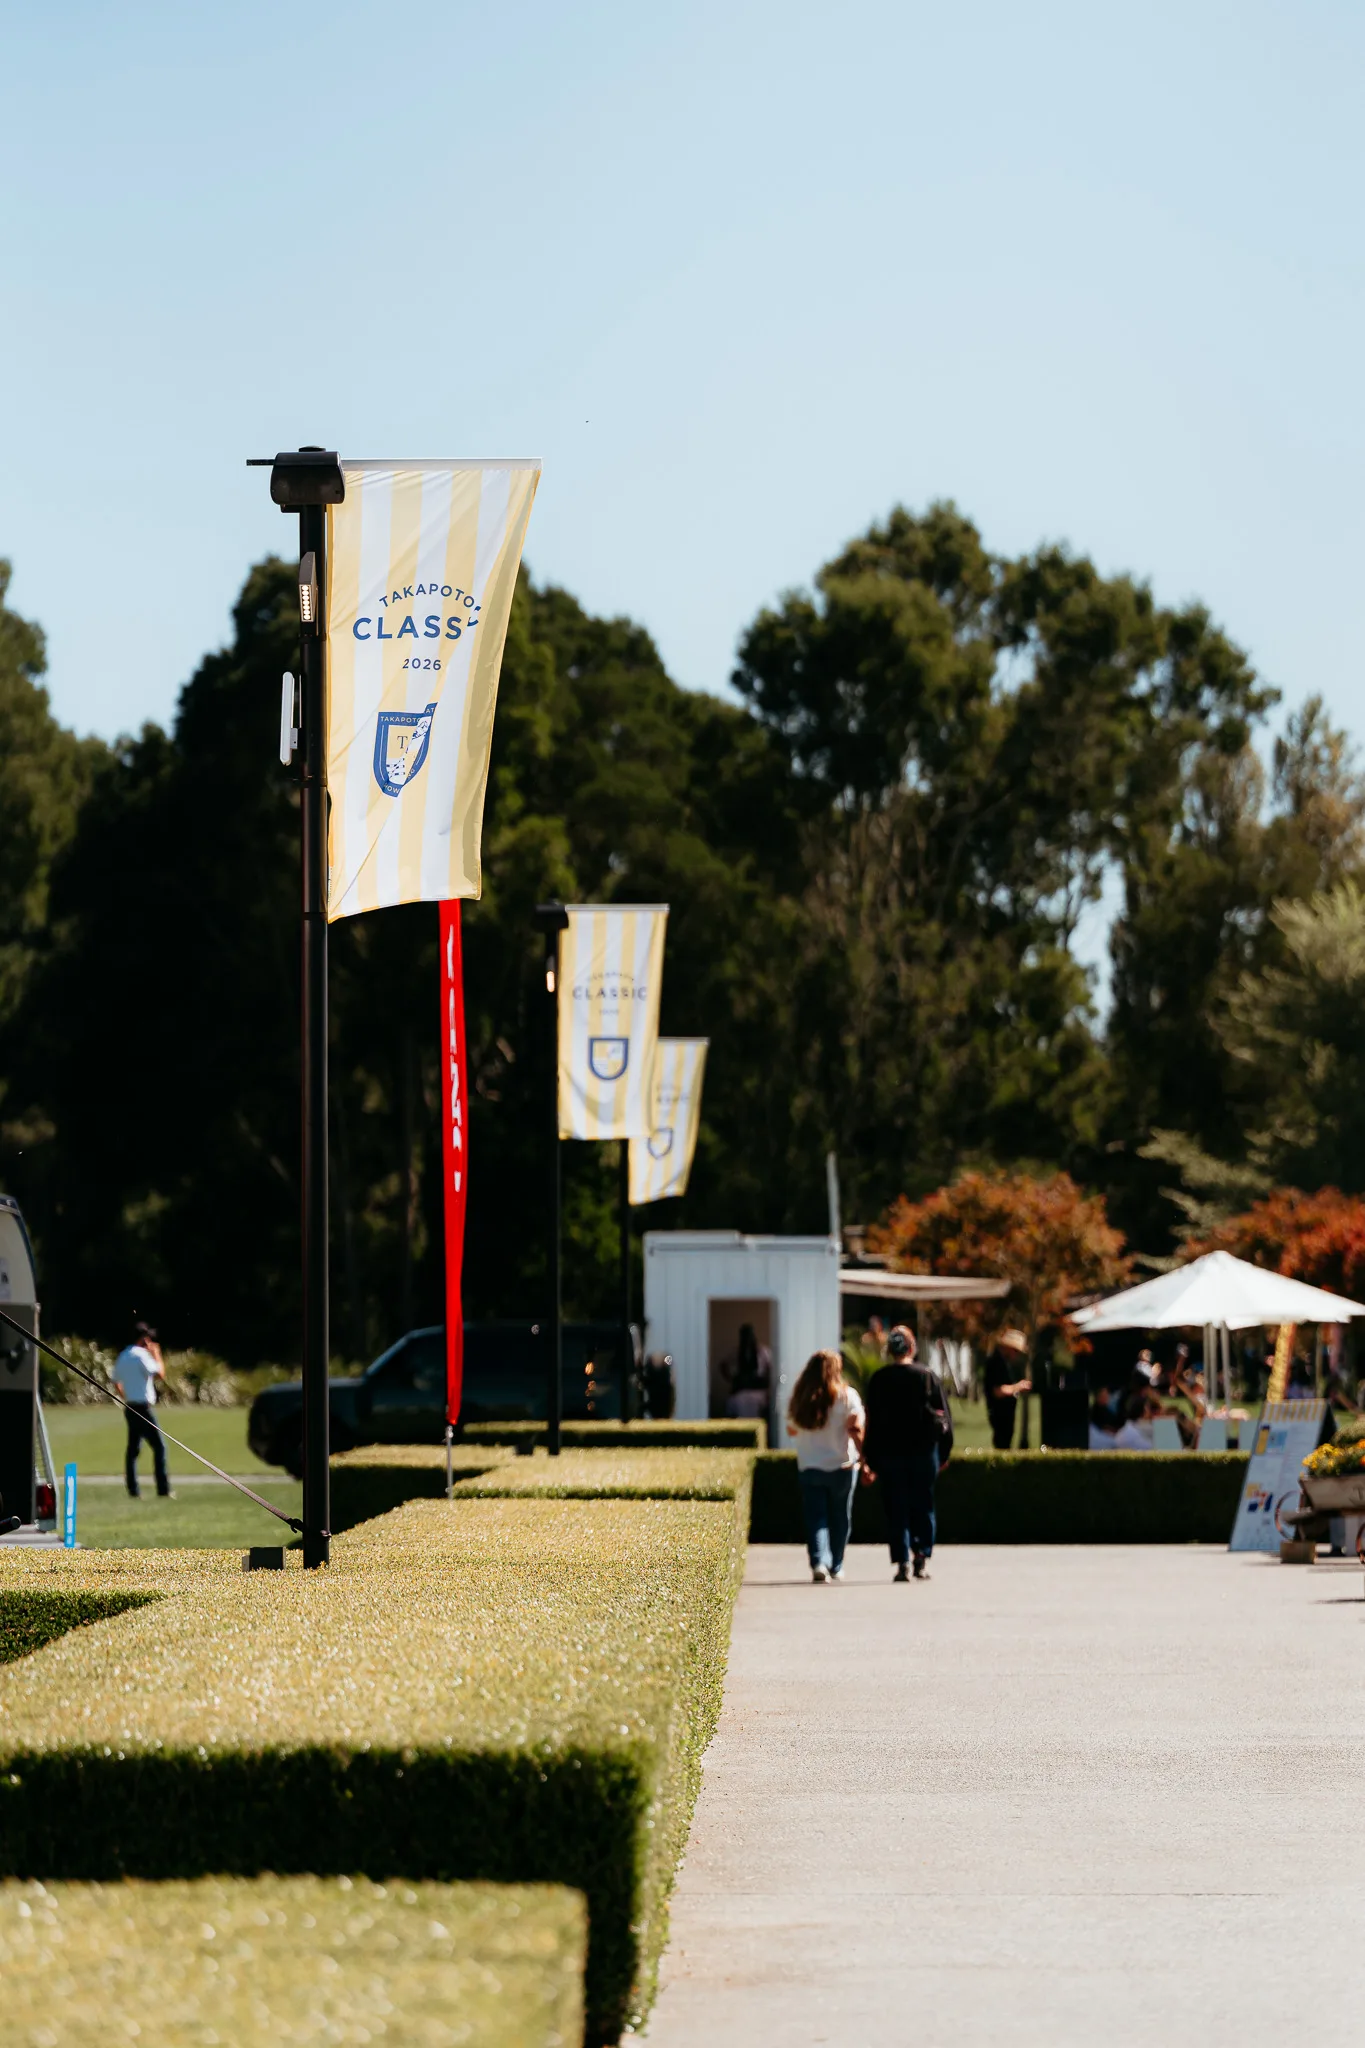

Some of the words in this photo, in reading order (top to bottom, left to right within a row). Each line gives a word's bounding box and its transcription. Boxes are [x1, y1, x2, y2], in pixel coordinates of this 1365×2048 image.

[379, 583, 475, 607] TAKAPOTO
[352, 605, 482, 640] CLASS
[402, 658, 442, 671] 2026
[572, 986, 647, 1001] CLASSIC
